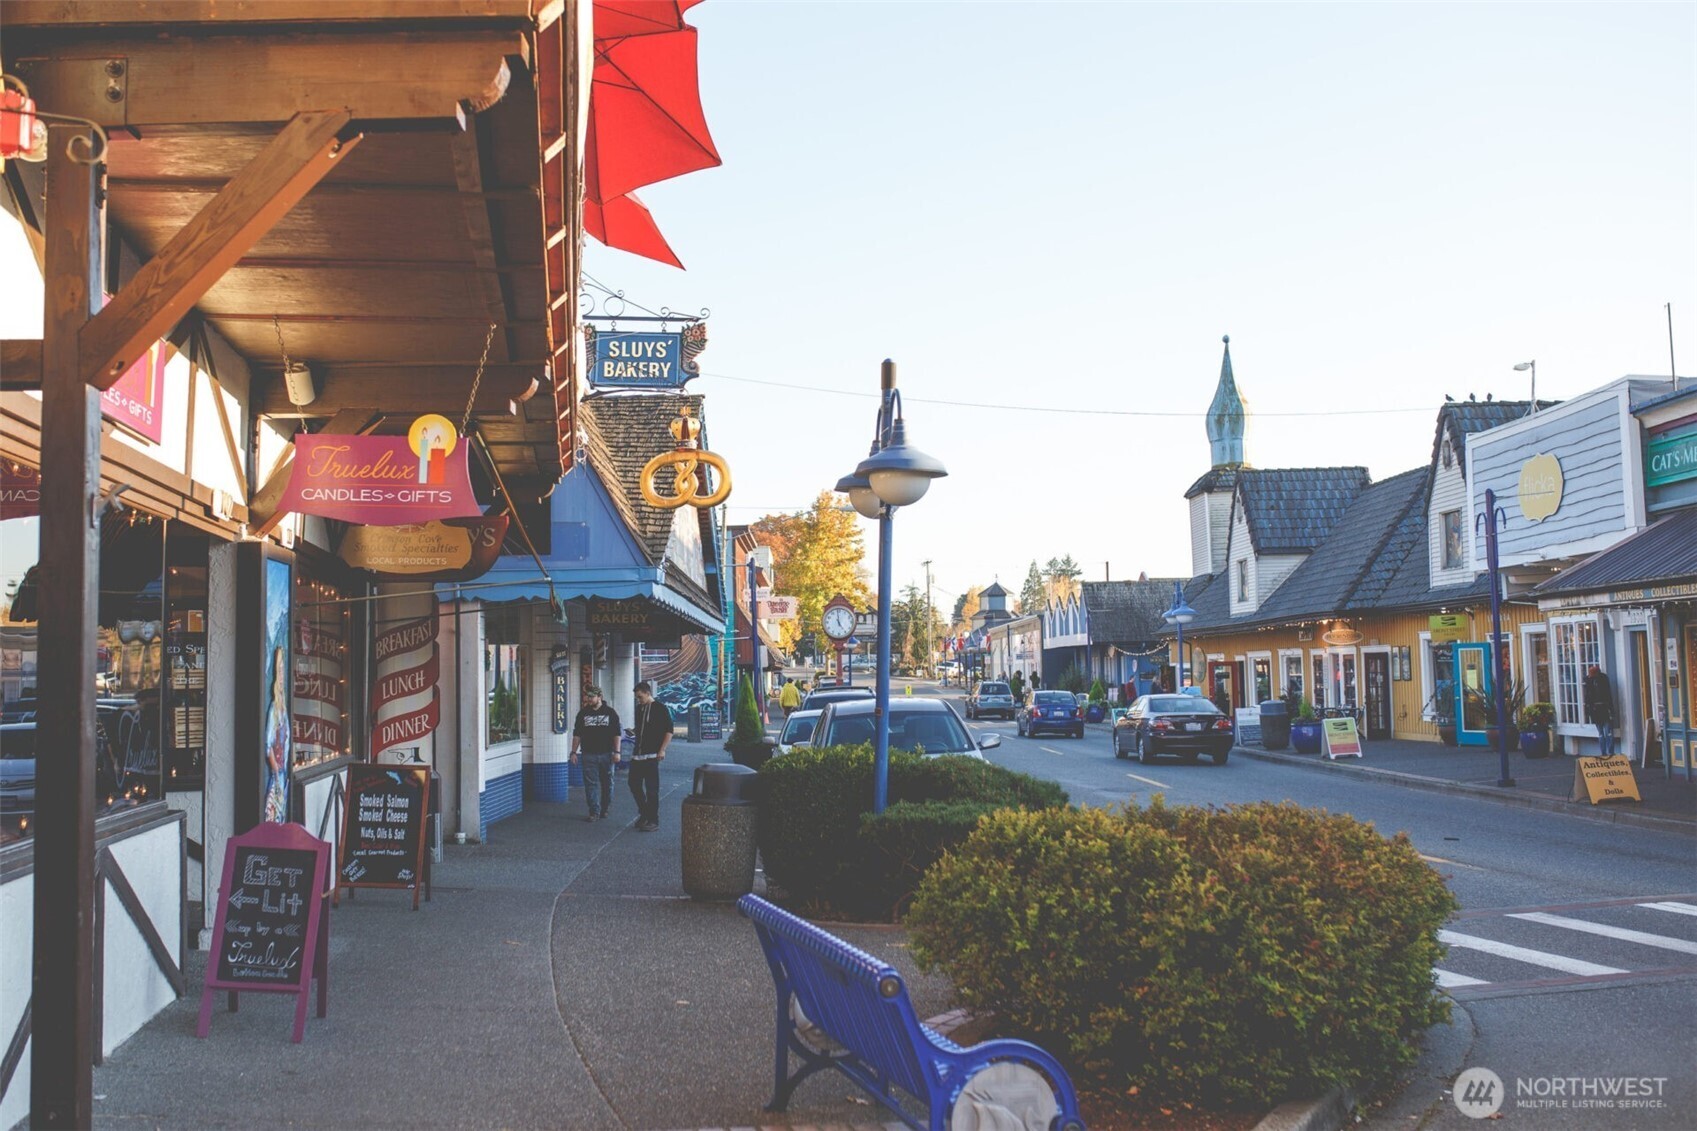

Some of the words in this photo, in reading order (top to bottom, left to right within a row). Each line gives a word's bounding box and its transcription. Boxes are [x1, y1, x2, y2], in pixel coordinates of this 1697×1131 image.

[609, 340, 673, 358] SLUYS'
[603, 361, 671, 378] BAKERY
[129, 399, 153, 425] GIFTS
[307, 445, 416, 479] Truelux
[1652, 450, 1680, 472] CAT'S
[301, 488, 384, 502] CANDLES
[397, 490, 452, 503] GIFTS
[418, 534, 443, 543] Cove
[354, 543, 396, 553] Smoked
[402, 543, 460, 554] Specialties
[366, 557, 395, 565] LOCAL
[399, 557, 448, 565] PRODUCTS
[1614, 589, 1644, 601] ANTIQUES
[592, 613, 648, 624] BAKERY
[376, 619, 433, 659] BREAKFAST
[382, 670, 426, 700] LUNCH
[557, 676, 565, 728] BAKERY
[382, 713, 432, 745] DINNER
[360, 793, 384, 807] Smoked
[387, 794, 409, 808] Salmon
[359, 808, 384, 822] Smoked
[386, 809, 408, 823] Cheese
[361, 827, 376, 841] Nuts,
[394, 829, 406, 840] Salt
[261, 889, 303, 916] Lit
[256, 921, 270, 936] by
[227, 940, 300, 970] Truelux
